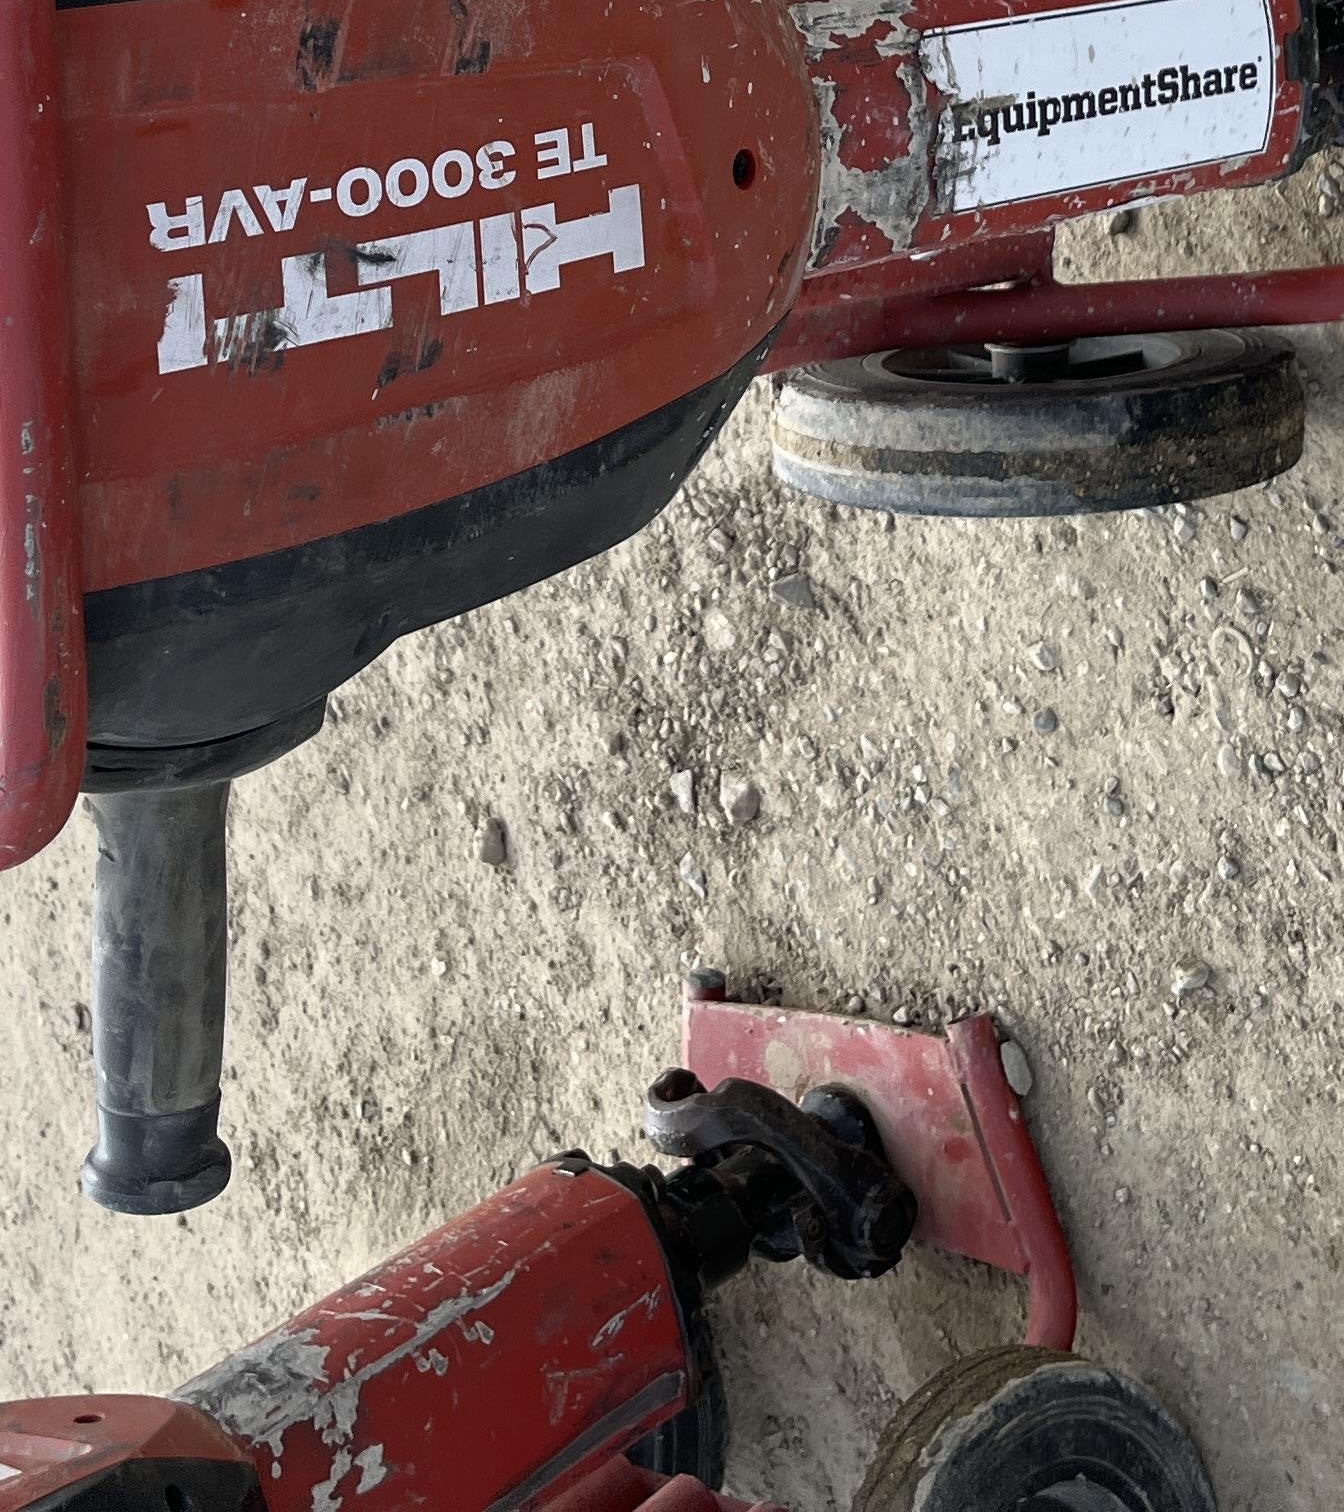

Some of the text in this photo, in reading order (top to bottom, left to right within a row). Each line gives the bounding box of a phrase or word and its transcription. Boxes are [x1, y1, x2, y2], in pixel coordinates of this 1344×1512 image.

[951, 59, 1258, 147] EquipmentShare
[145, 121, 609, 253] TE 3000-AVR
[157, 183, 646, 376] HILTI
